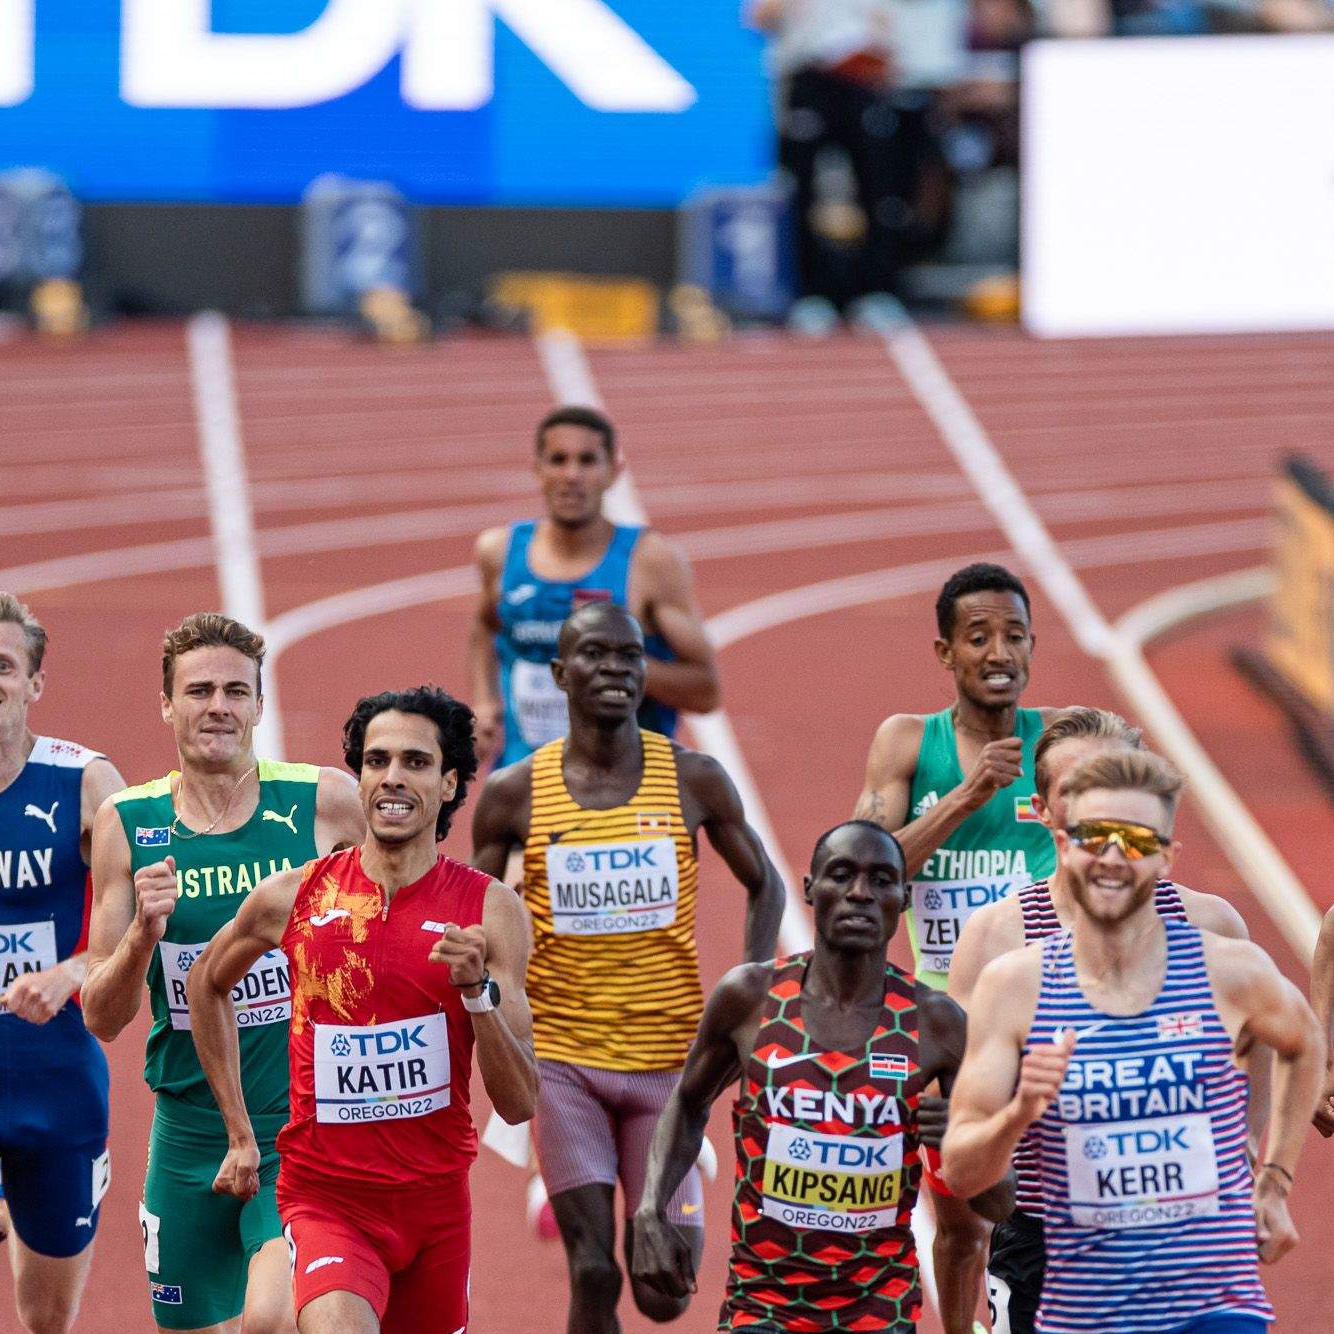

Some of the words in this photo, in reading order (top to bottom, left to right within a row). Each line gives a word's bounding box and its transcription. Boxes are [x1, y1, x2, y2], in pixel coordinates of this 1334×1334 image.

[586, 846, 657, 871] TDK
[557, 876, 672, 909] MUSAGALA
[941, 882, 1011, 909] TDK
[572, 913, 659, 931] OREGON22
[350, 1024, 428, 1057] TDK
[337, 1058, 428, 1094] KATIR
[1061, 1053, 1202, 1090] GREAT
[338, 1098, 433, 1120] OREGON22
[766, 1086, 901, 1125] KENYA
[1058, 1084, 1204, 1121] BRITAIN
[813, 1141, 889, 1167] TDK
[1107, 1125, 1190, 1155] TDK
[772, 1164, 894, 1204] KIPSANG
[1097, 1162, 1183, 1198] KERR
[782, 1208, 877, 1228] OREGON22
[1093, 1202, 1195, 1224] OREGON22
